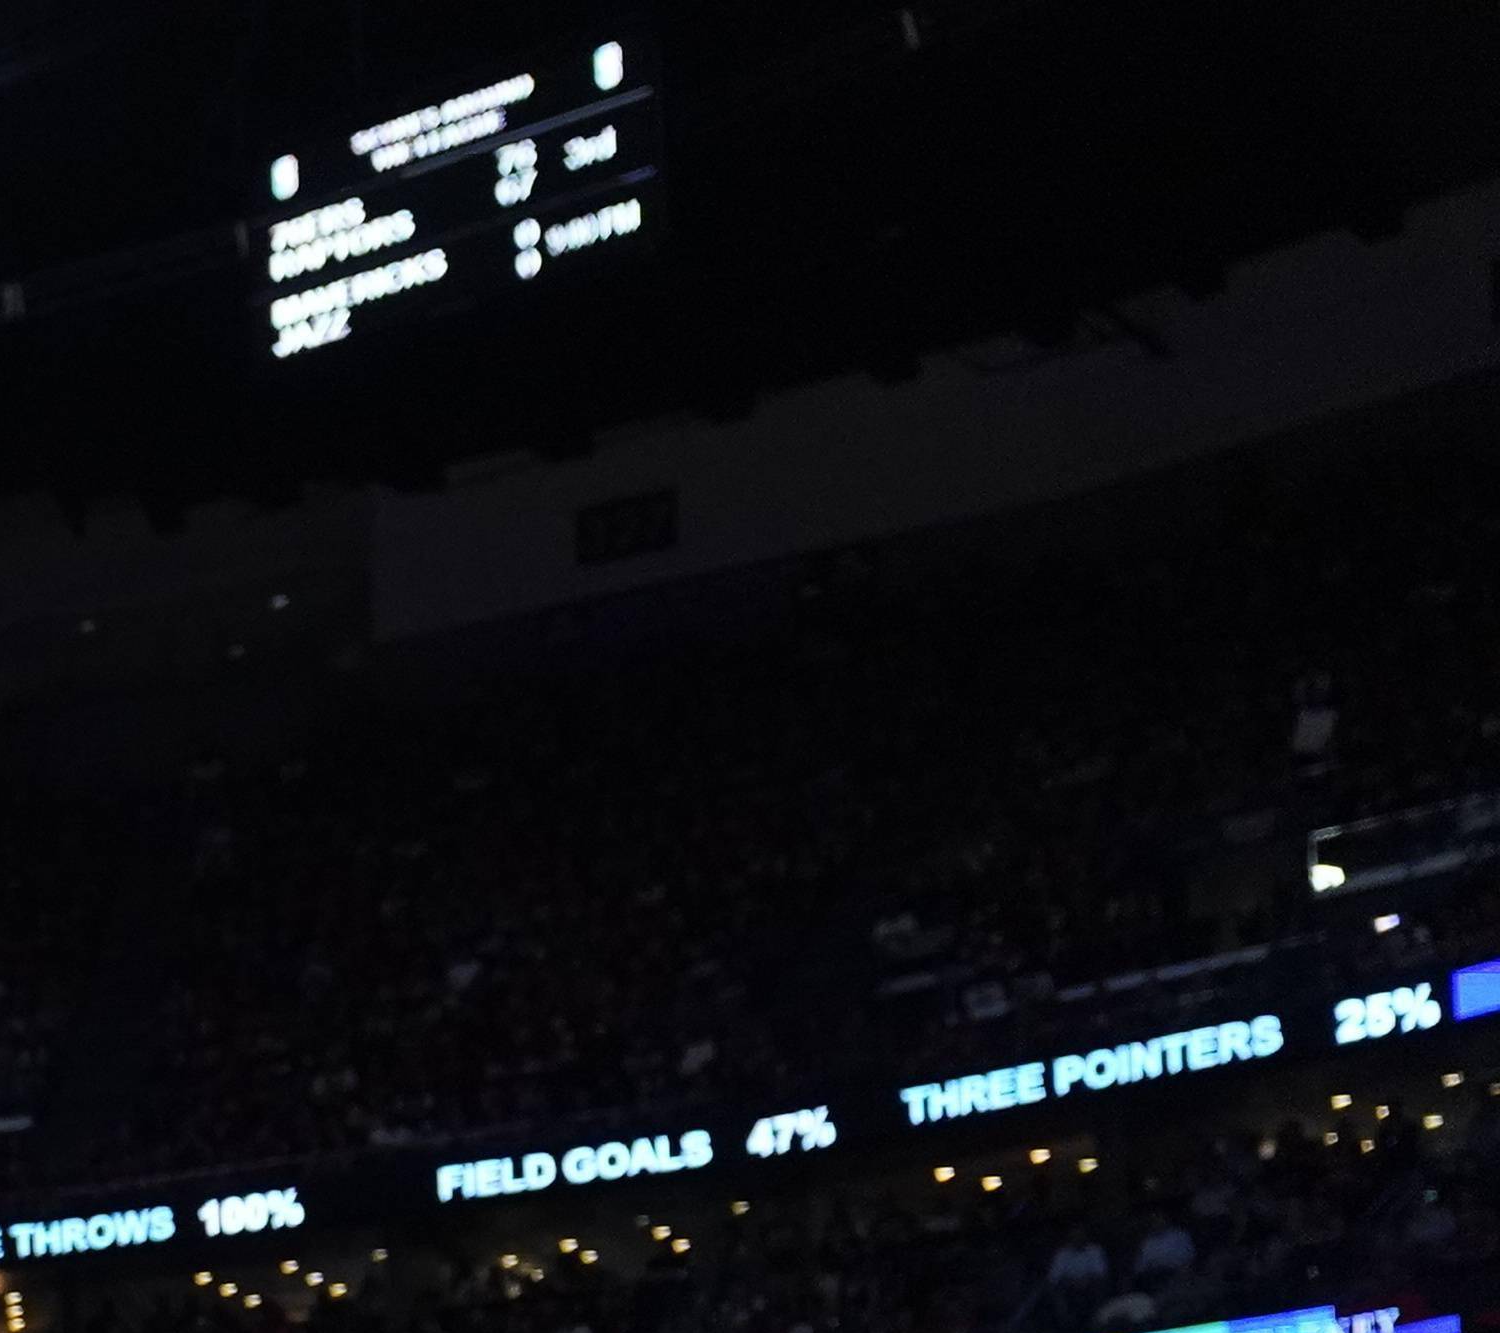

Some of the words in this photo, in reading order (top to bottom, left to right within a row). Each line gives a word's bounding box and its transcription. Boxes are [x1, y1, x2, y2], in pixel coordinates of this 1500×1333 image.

[902, 1062, 1045, 1126] THREE
[1054, 1015, 1283, 1096] POINTERS
[1334, 983, 1442, 1045] 25%
[438, 1155, 555, 1201] FIELD
[563, 1129, 712, 1182] GOALS
[746, 1106, 836, 1159] 47%
[10, 1206, 175, 1258] THROWS
[199, 1186, 304, 1237] 100%
